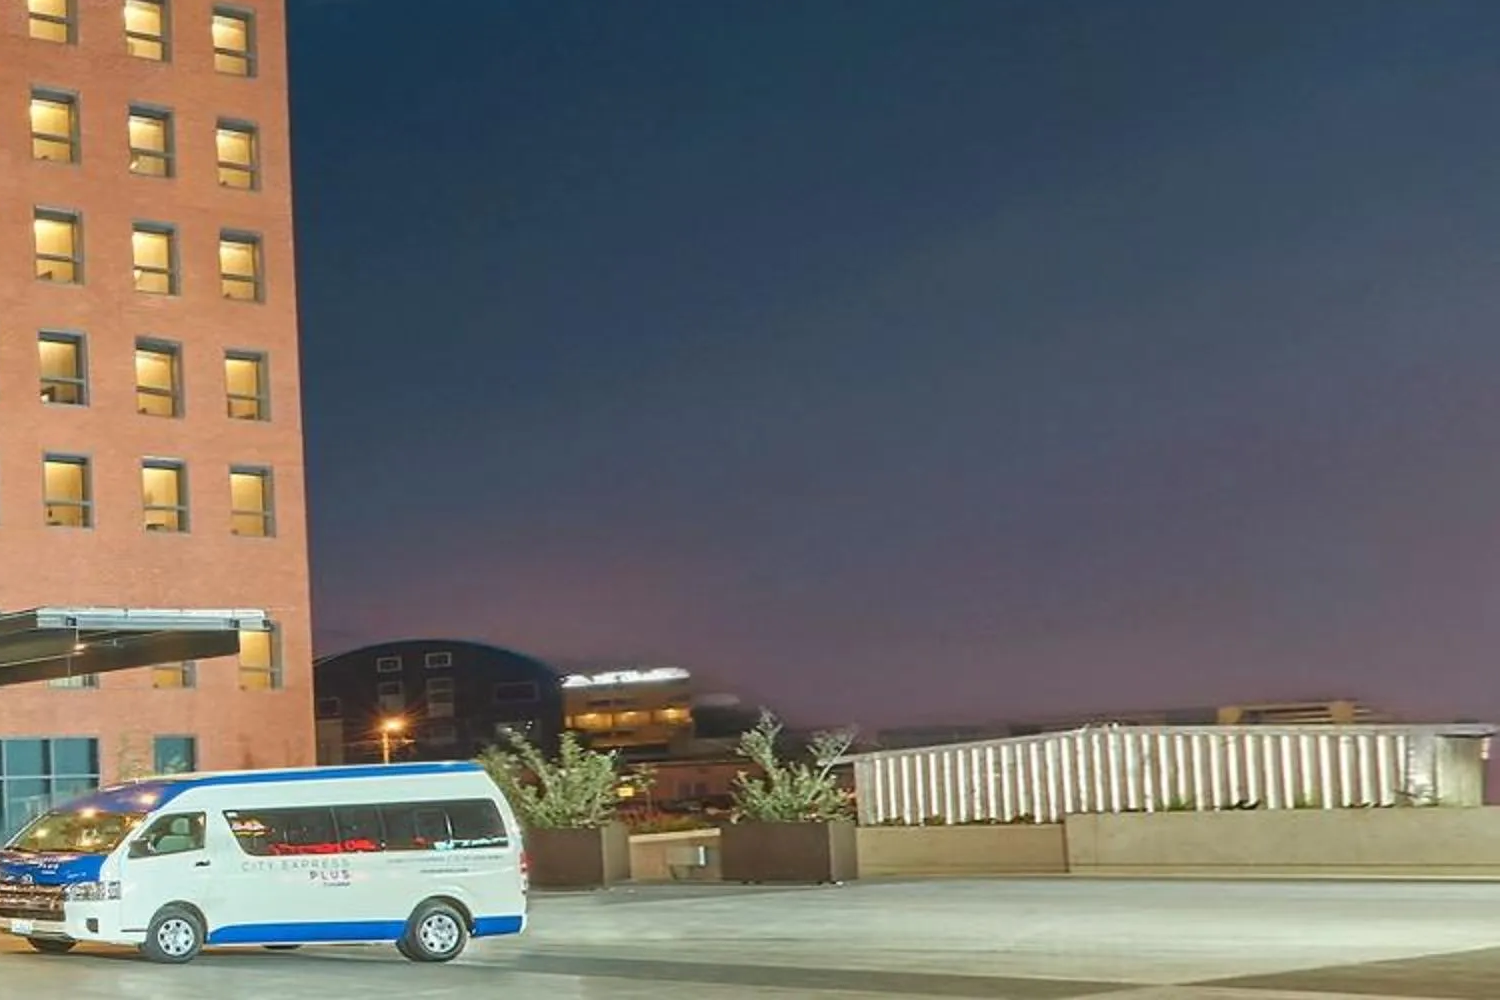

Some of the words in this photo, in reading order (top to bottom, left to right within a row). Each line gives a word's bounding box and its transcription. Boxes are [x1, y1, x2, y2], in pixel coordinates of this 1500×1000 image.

[241, 860, 274, 872] CITY
[281, 859, 351, 871] EXPRESS
[309, 869, 351, 880] PLUS
